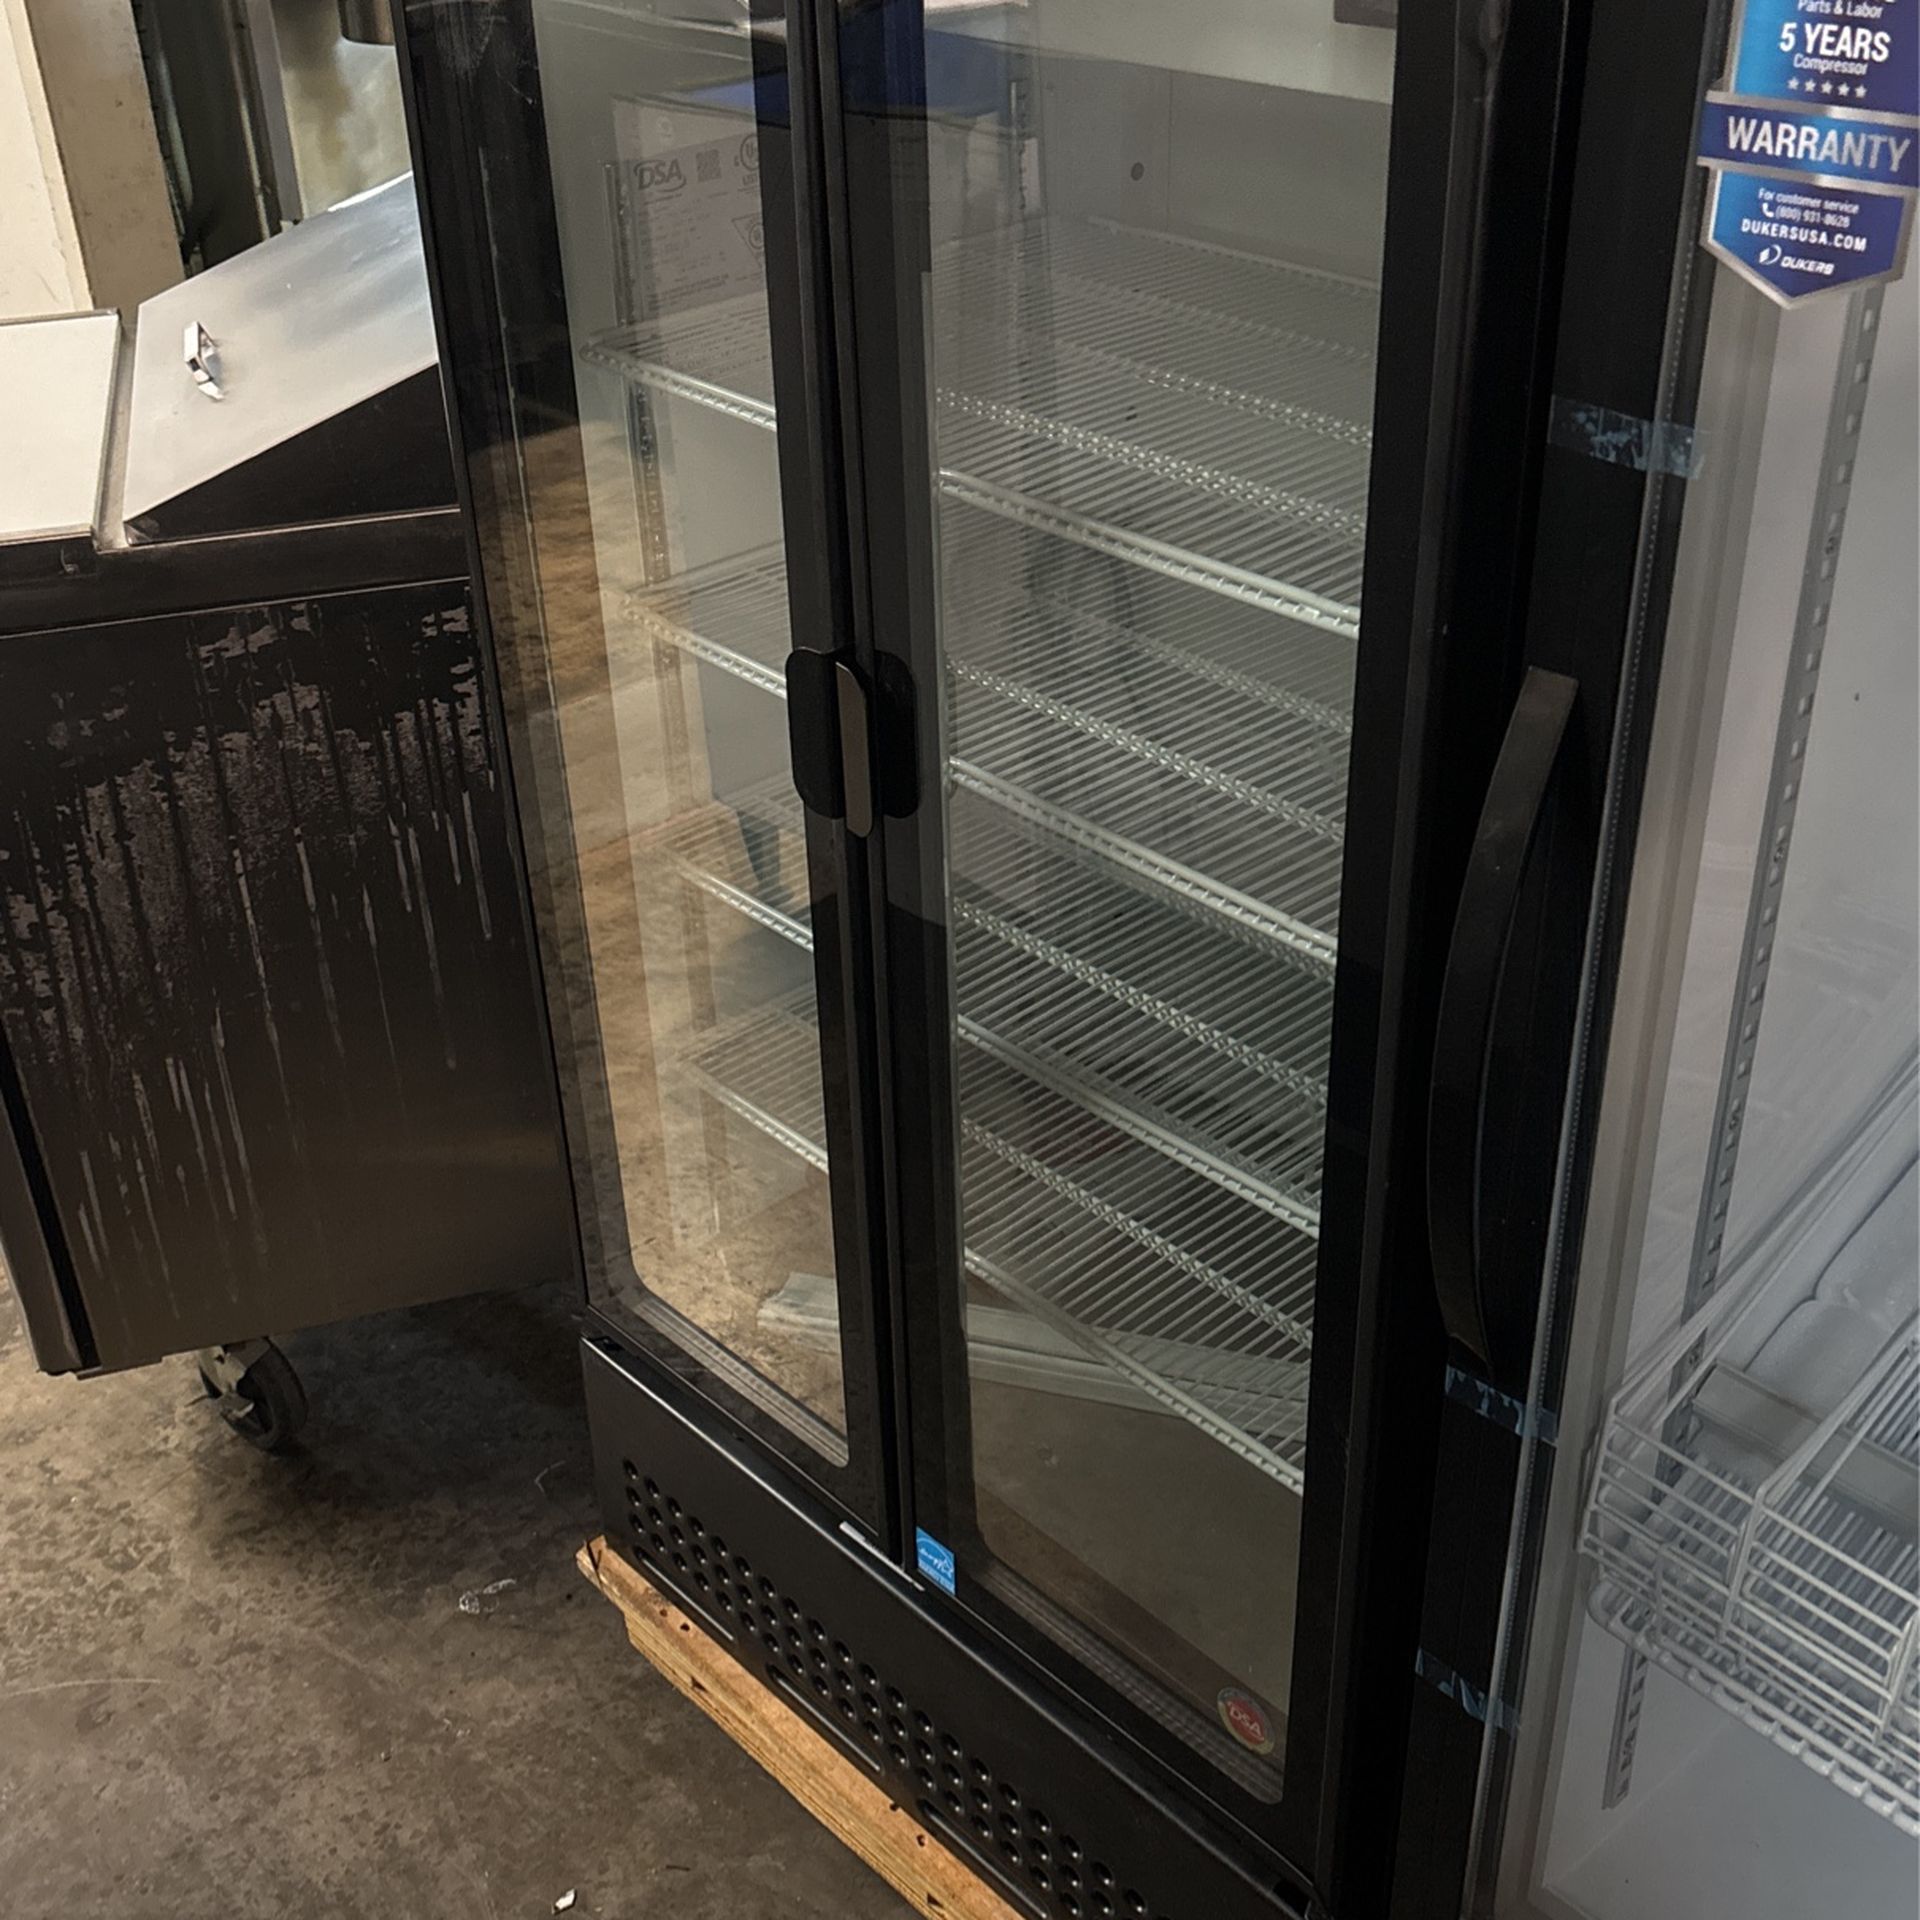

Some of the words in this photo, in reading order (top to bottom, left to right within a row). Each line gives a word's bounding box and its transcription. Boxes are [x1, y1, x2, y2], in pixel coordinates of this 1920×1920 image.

[1797, 0, 1831, 14] Parts
[1833, 1, 1843, 15] &
[1847, 2, 1883, 18] Labor
[1780, 22, 1797, 52] 5
[1804, 22, 1891, 62] YEARS
[1793, 53, 1868, 75] Compressor
[1727, 116, 1910, 173] WARRANTY
[639, 158, 682, 190] DSA
[1758, 187, 1775, 200] For
[1776, 193, 1821, 208] customer
[1823, 199, 1859, 214] service
[1741, 218, 1867, 252] DUKERSUSA.COM
[1781, 256, 1834, 275] DUKERS
[1229, 1704, 1262, 1737] DSA
